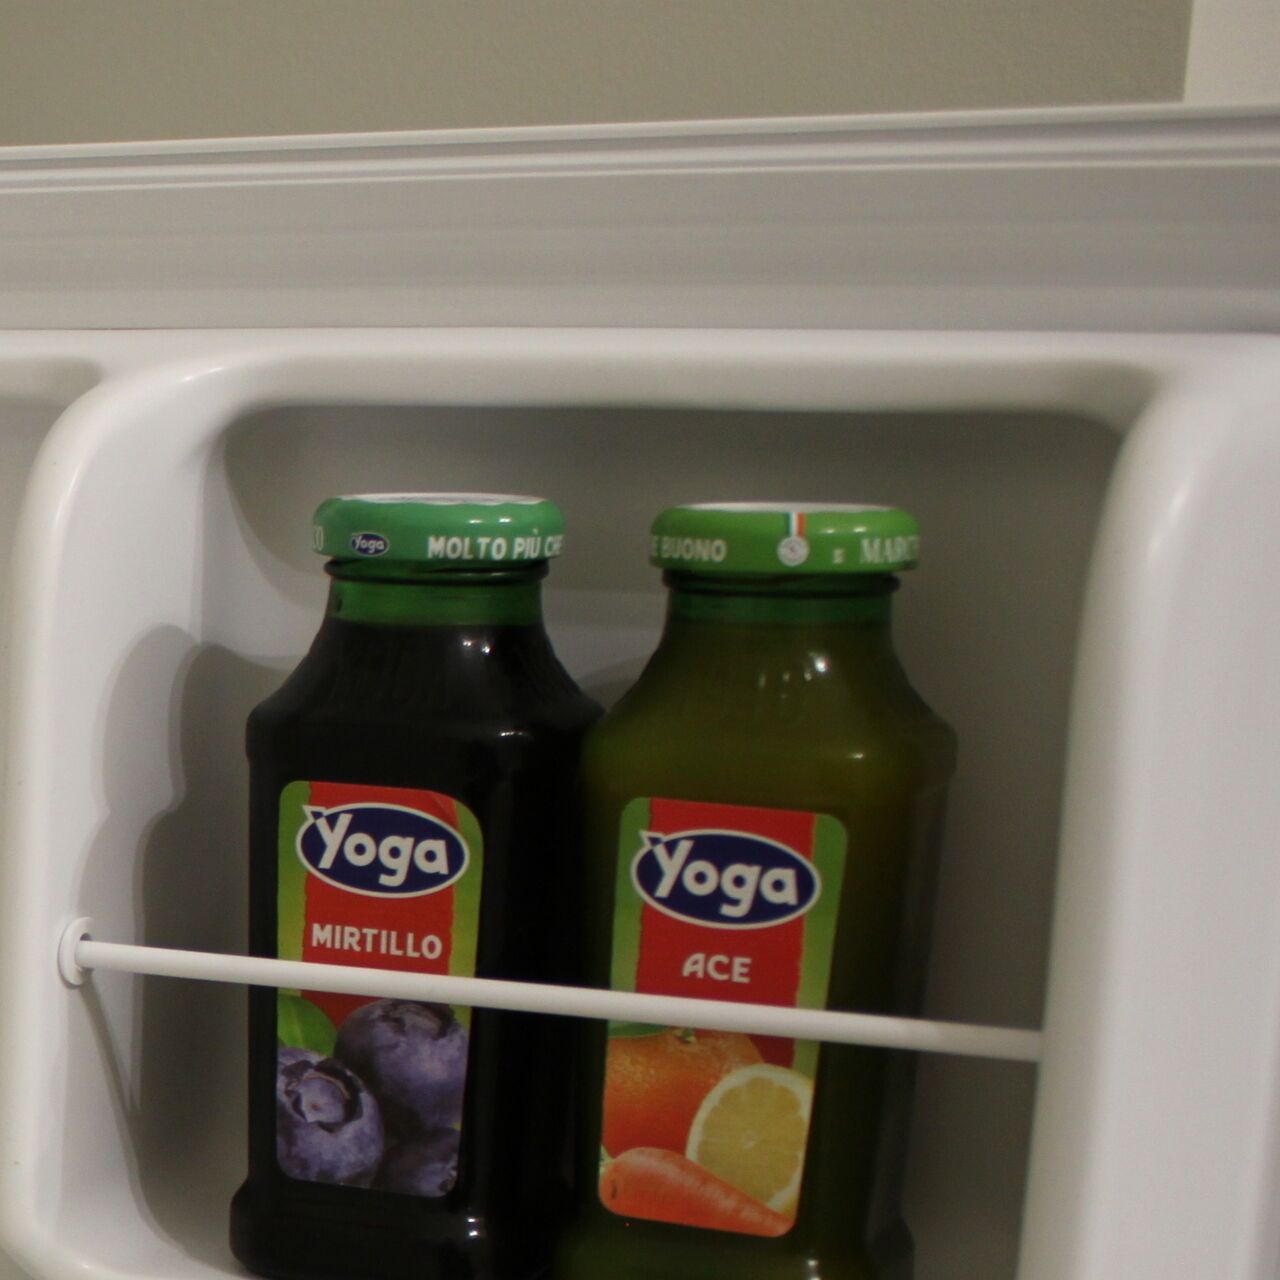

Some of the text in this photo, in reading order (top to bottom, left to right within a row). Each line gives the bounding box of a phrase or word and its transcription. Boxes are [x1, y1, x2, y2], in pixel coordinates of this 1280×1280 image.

[426, 535, 507, 559] MOLTO
[512, 528, 539, 559] PIÙ
[662, 537, 727, 562] BUONO
[315, 813, 450, 887] Yoga
[653, 840, 798, 918] Yoga
[311, 922, 442, 960] MIRTILLO
[681, 952, 752, 983] ACE
